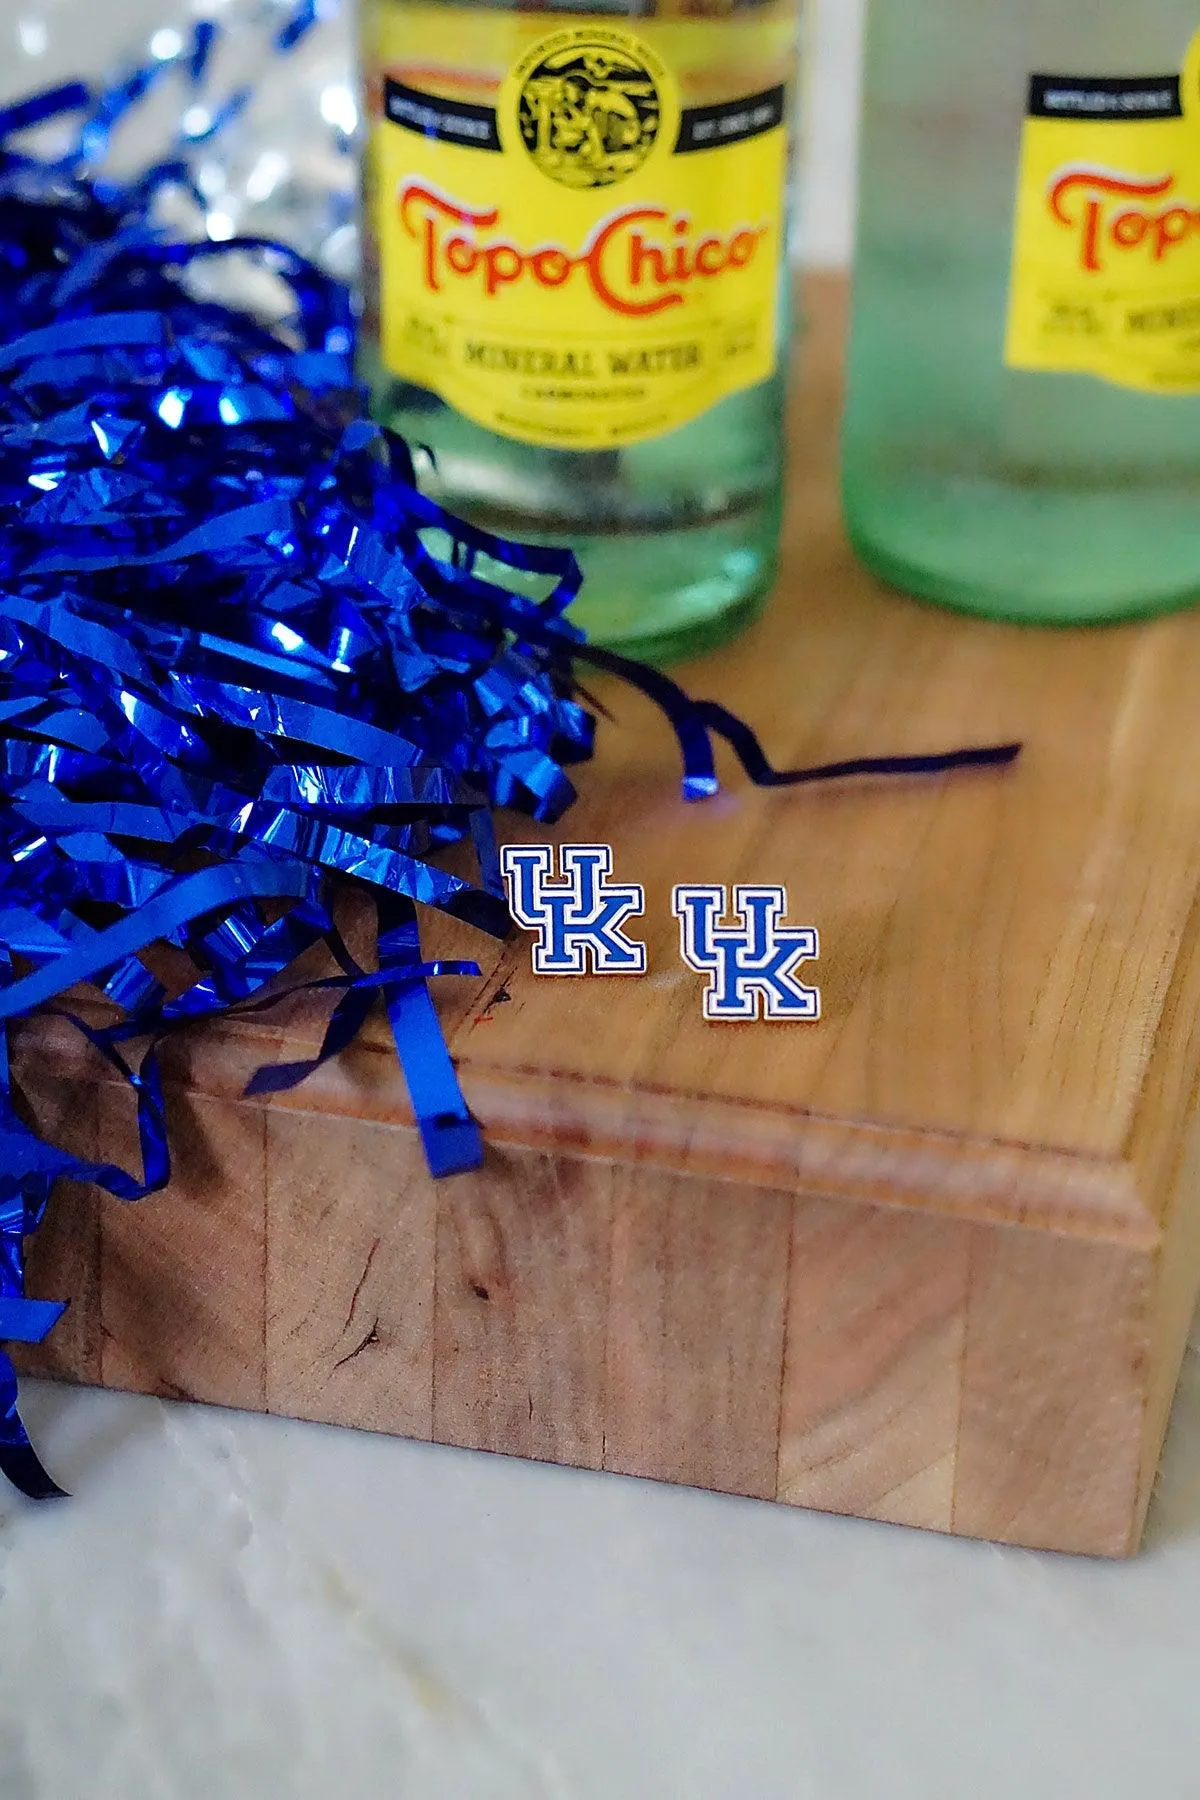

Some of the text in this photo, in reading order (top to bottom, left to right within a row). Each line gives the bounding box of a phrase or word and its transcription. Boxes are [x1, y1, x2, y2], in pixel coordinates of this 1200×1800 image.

[400, 184, 766, 318] Topo Chico
[1047, 172, 1200, 272] Top
[463, 338, 700, 379] MINERAL WATER
[501, 844, 647, 975] UK
[672, 884, 821, 1021] UK
